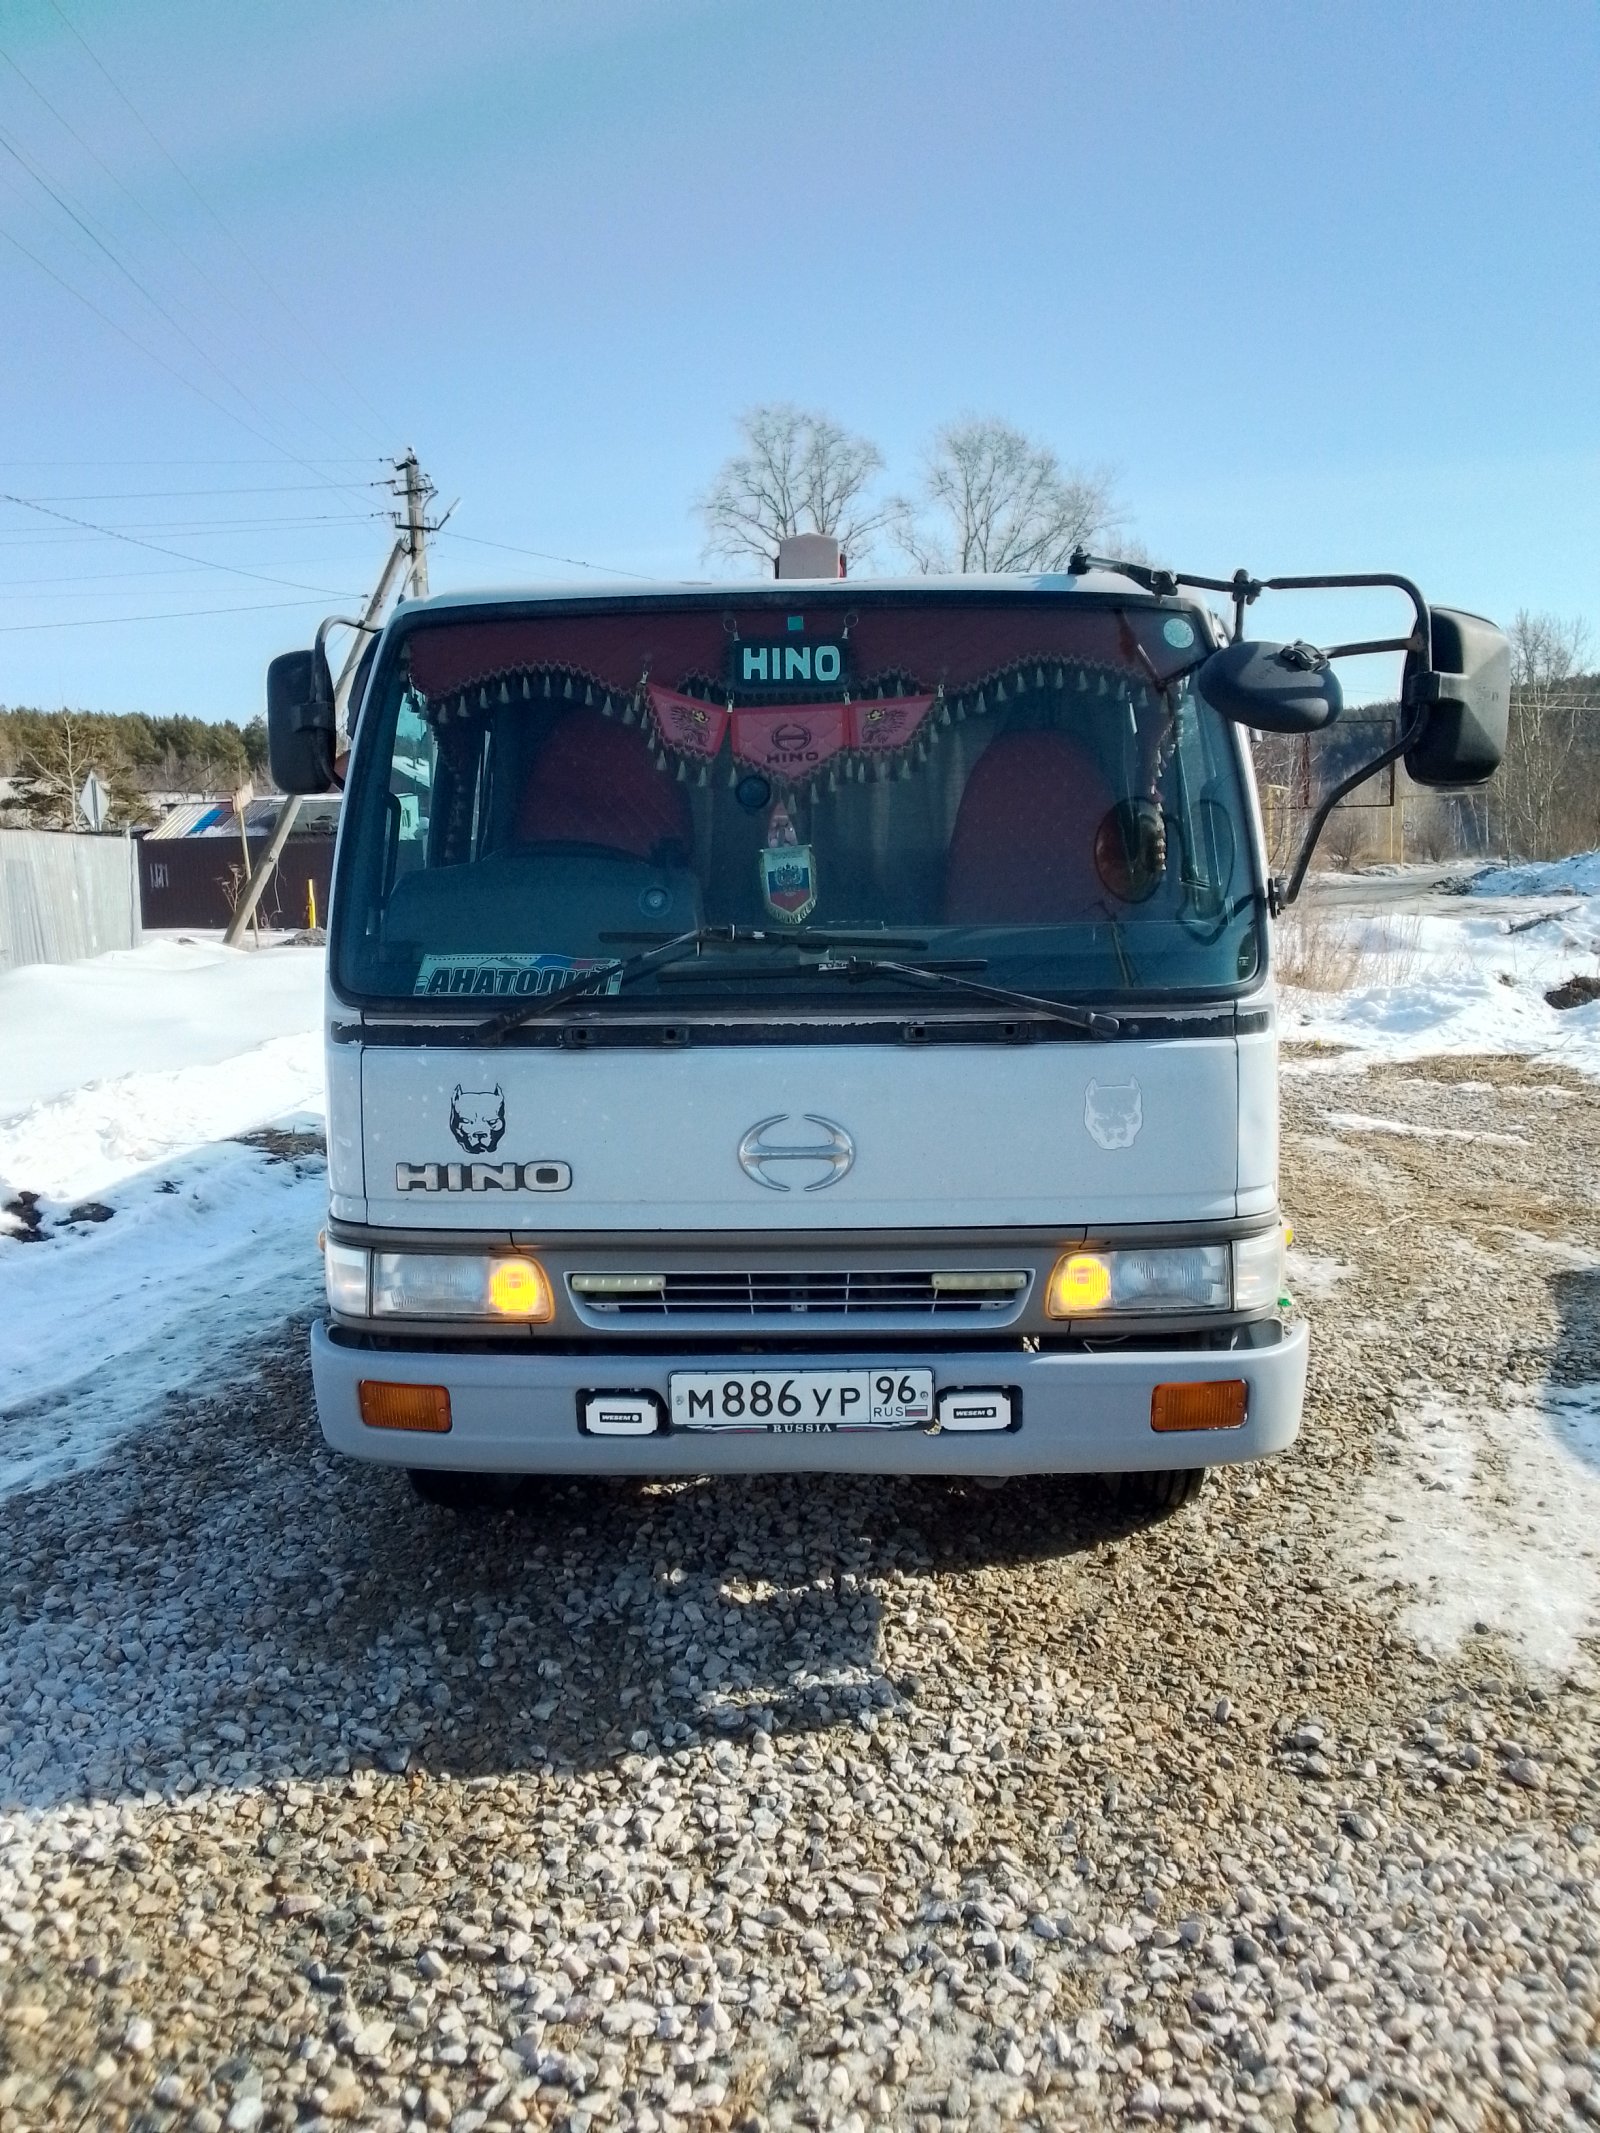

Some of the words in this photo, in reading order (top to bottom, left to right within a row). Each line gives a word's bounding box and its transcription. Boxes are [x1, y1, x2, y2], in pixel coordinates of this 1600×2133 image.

[743, 646, 840, 681] HINO
[766, 751, 819, 763] HINO
[396, 1160, 572, 1191] HINO
[875, 1375, 916, 1404] 96
[873, 1406, 904, 1417] RUS
[772, 1424, 833, 1433] RUSSIA
